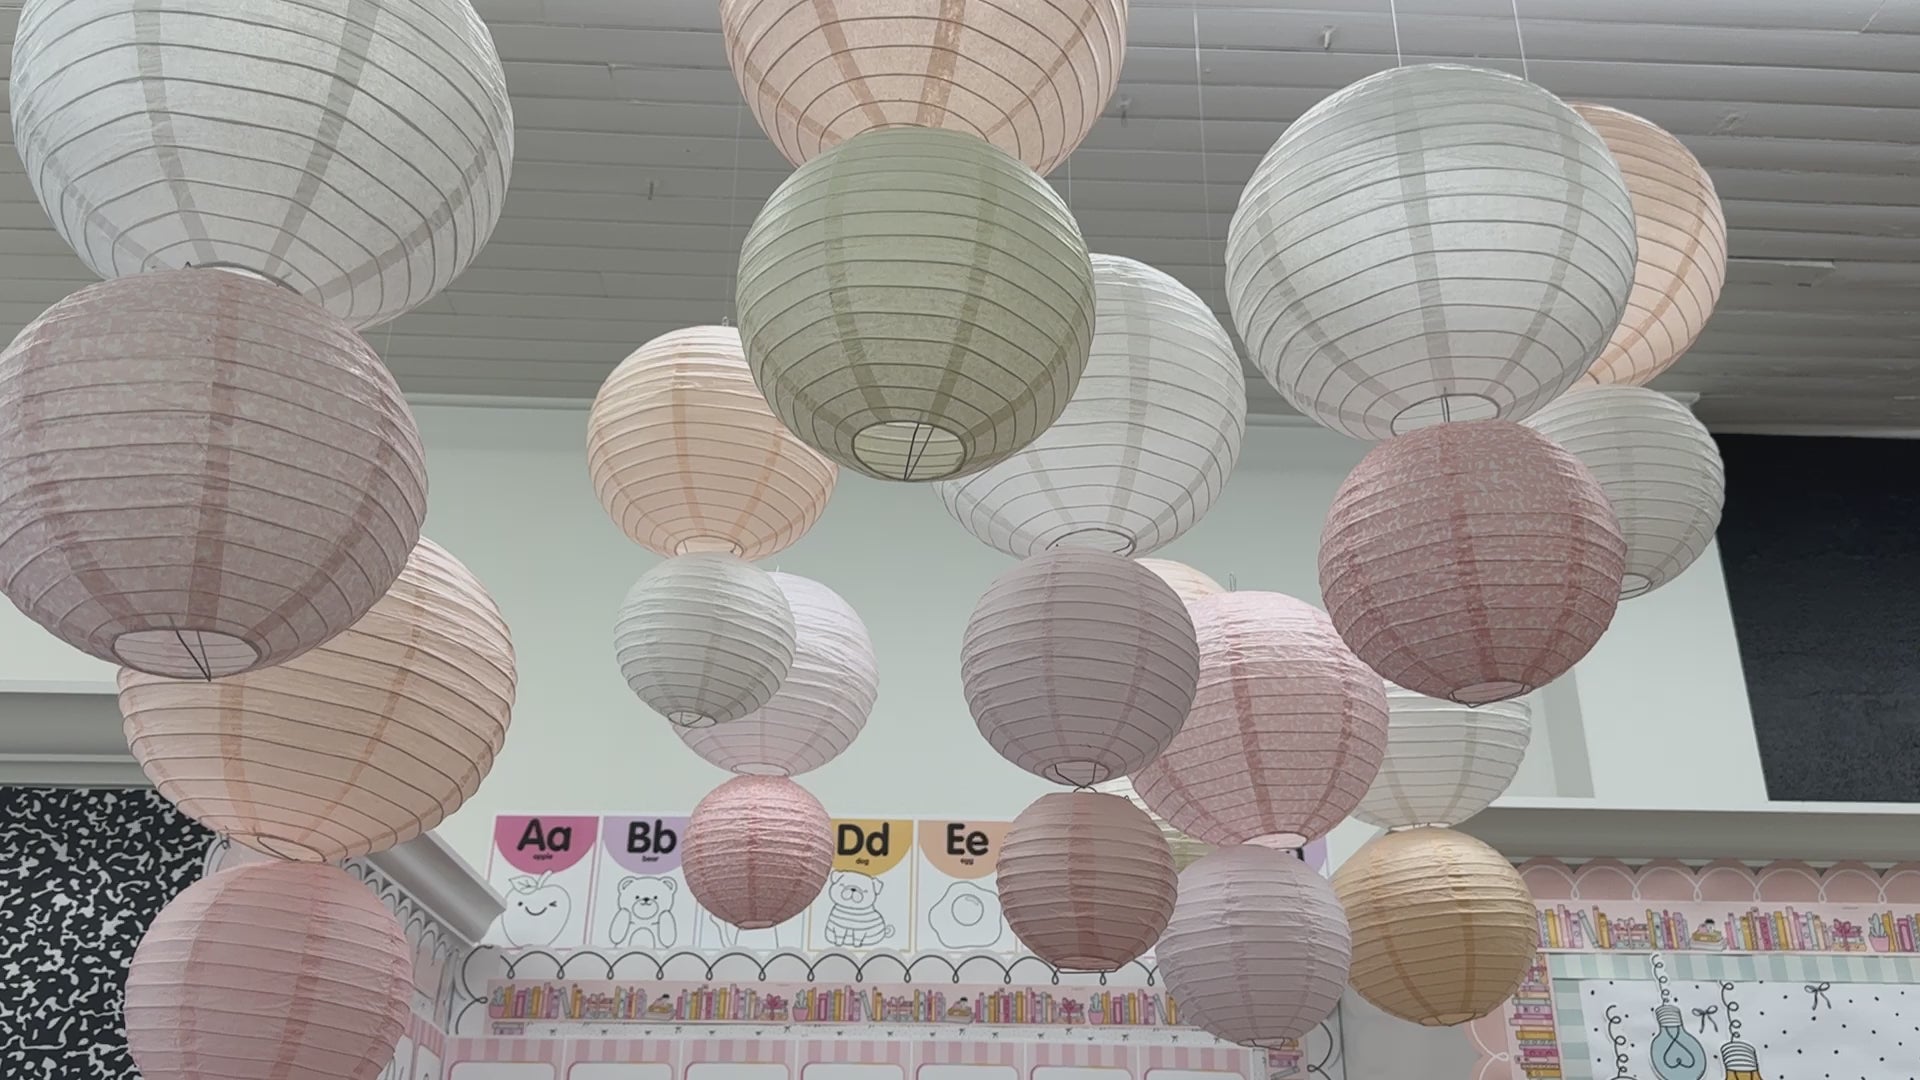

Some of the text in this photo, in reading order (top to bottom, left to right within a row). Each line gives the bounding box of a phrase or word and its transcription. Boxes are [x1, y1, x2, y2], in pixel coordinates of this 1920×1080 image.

[517, 819, 572, 851] Aa
[627, 819, 677, 854] Bb
[837, 822, 890, 856] Dd
[947, 823, 989, 856] Ee
[533, 853, 553, 861] apple
[642, 855, 659, 863] bear
[855, 857, 870, 866] dog
[960, 858, 974, 866] egg
